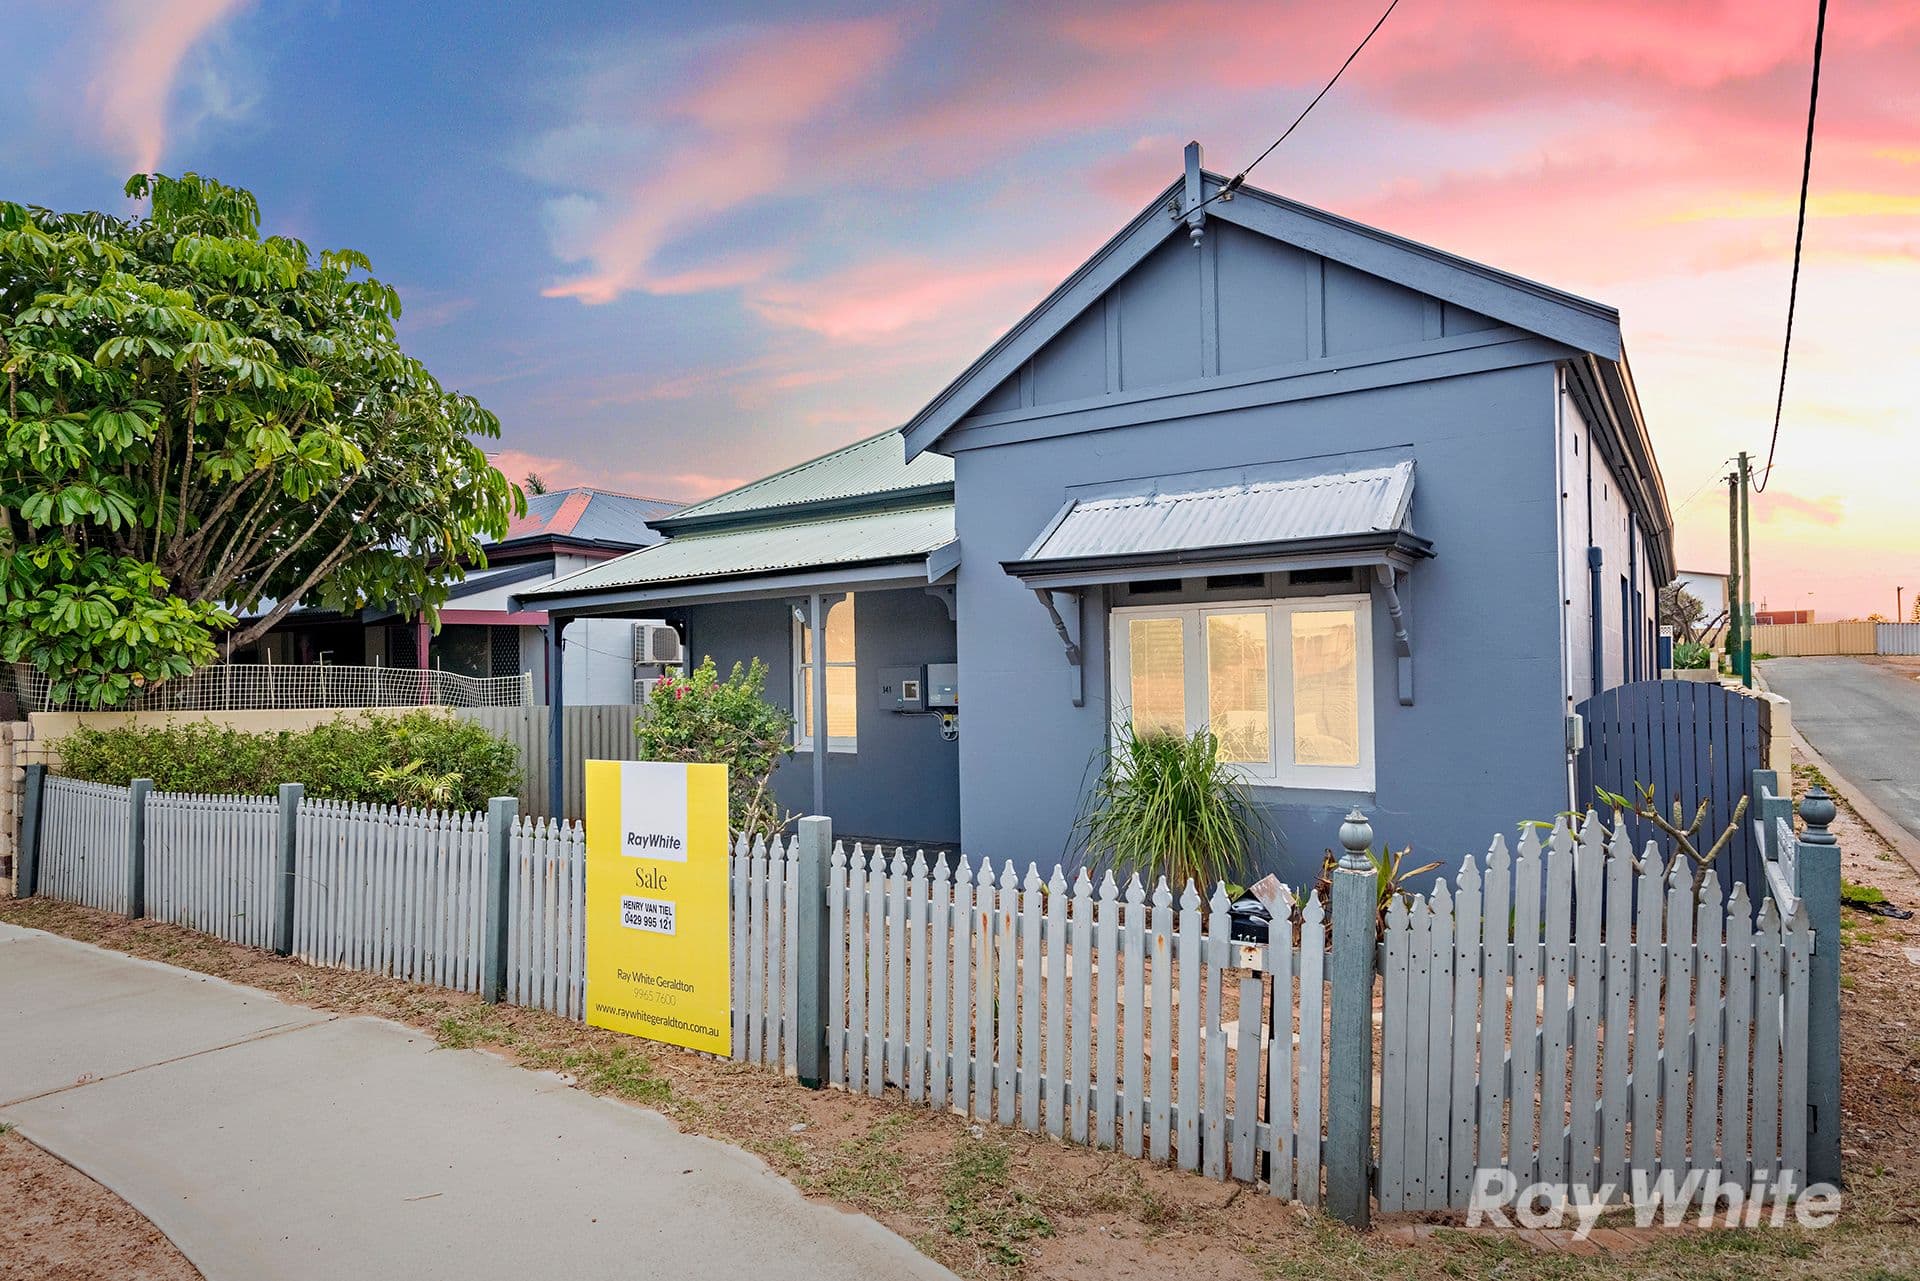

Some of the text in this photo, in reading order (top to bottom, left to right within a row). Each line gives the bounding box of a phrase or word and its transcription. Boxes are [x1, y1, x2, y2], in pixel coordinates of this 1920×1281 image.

[635, 867, 668, 891] Sale
[623, 900, 673, 916] HENRY VAN TIEL
[624, 912, 672, 930] 0429 995 121
[617, 968, 695, 993] Ray White Geraldton
[633, 987, 677, 1006] 9965 7600
[595, 1002, 720, 1037] www.raywhitegeraldton.com.au
